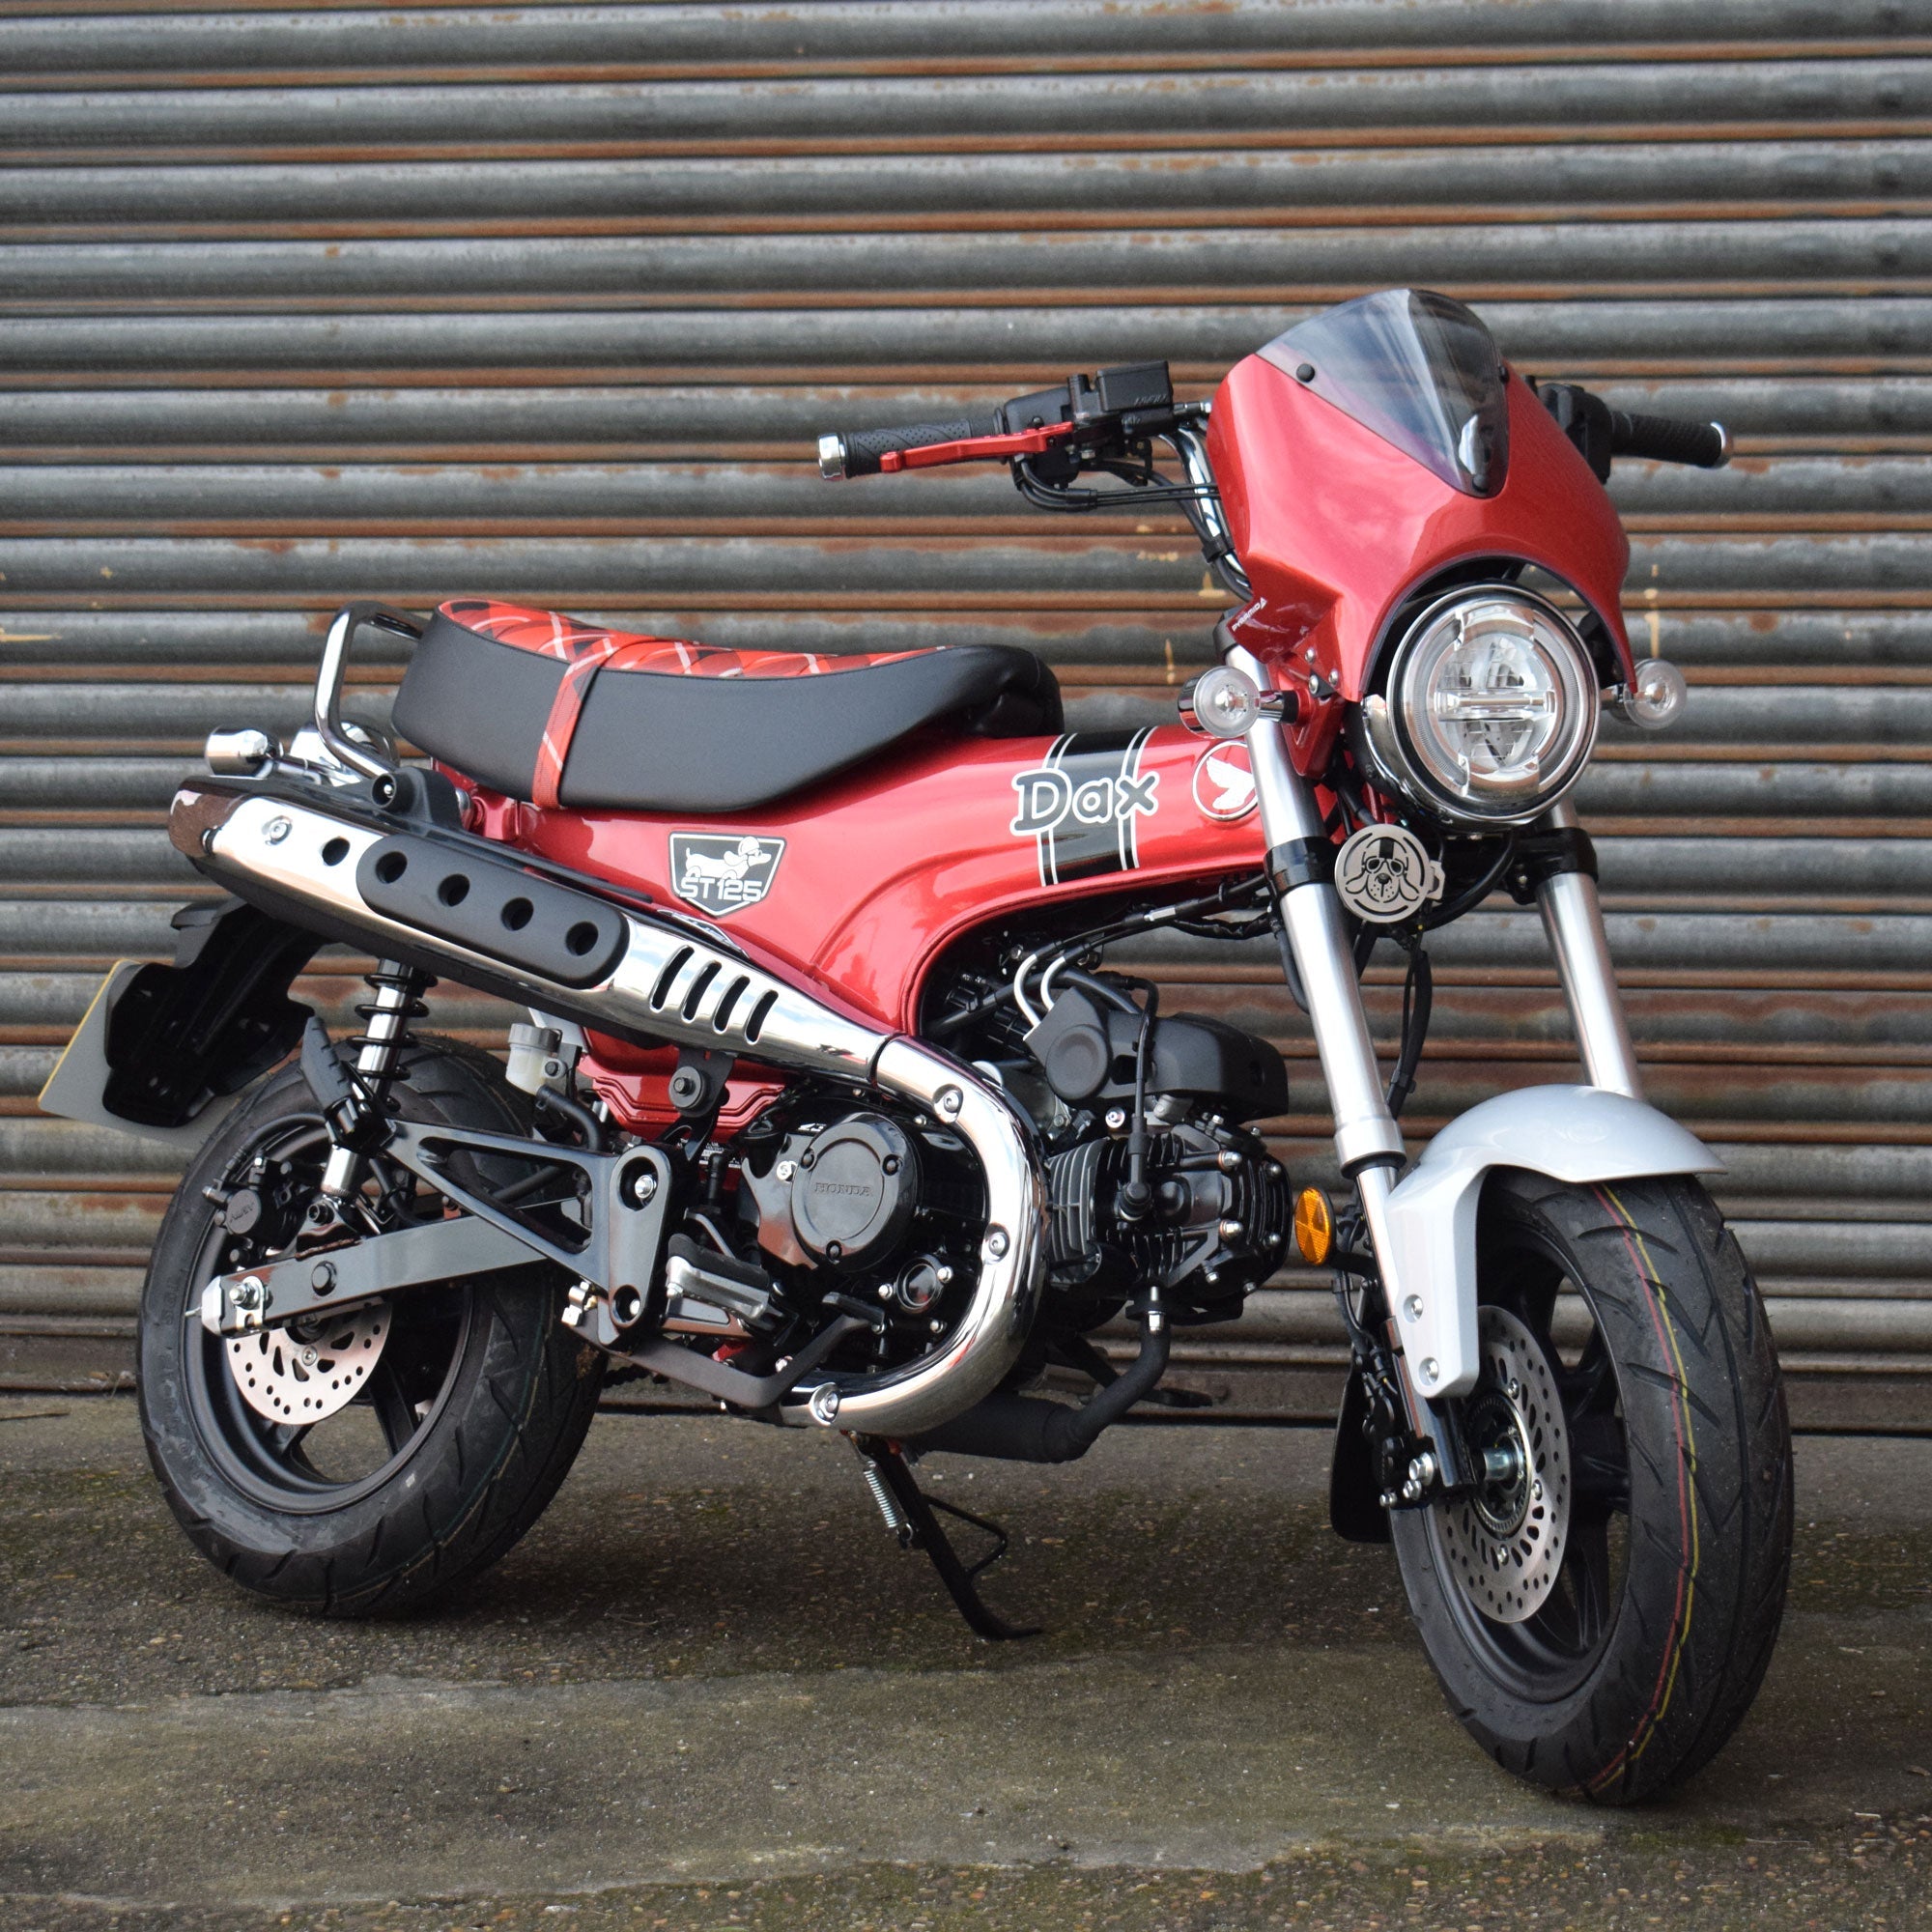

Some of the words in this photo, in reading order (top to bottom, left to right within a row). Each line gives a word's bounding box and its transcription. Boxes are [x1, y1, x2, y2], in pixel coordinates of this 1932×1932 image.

[1232, 601, 1262, 632] PYRAMID
[1009, 768, 1160, 836] Dax
[814, 1181, 873, 1197] HONDA
